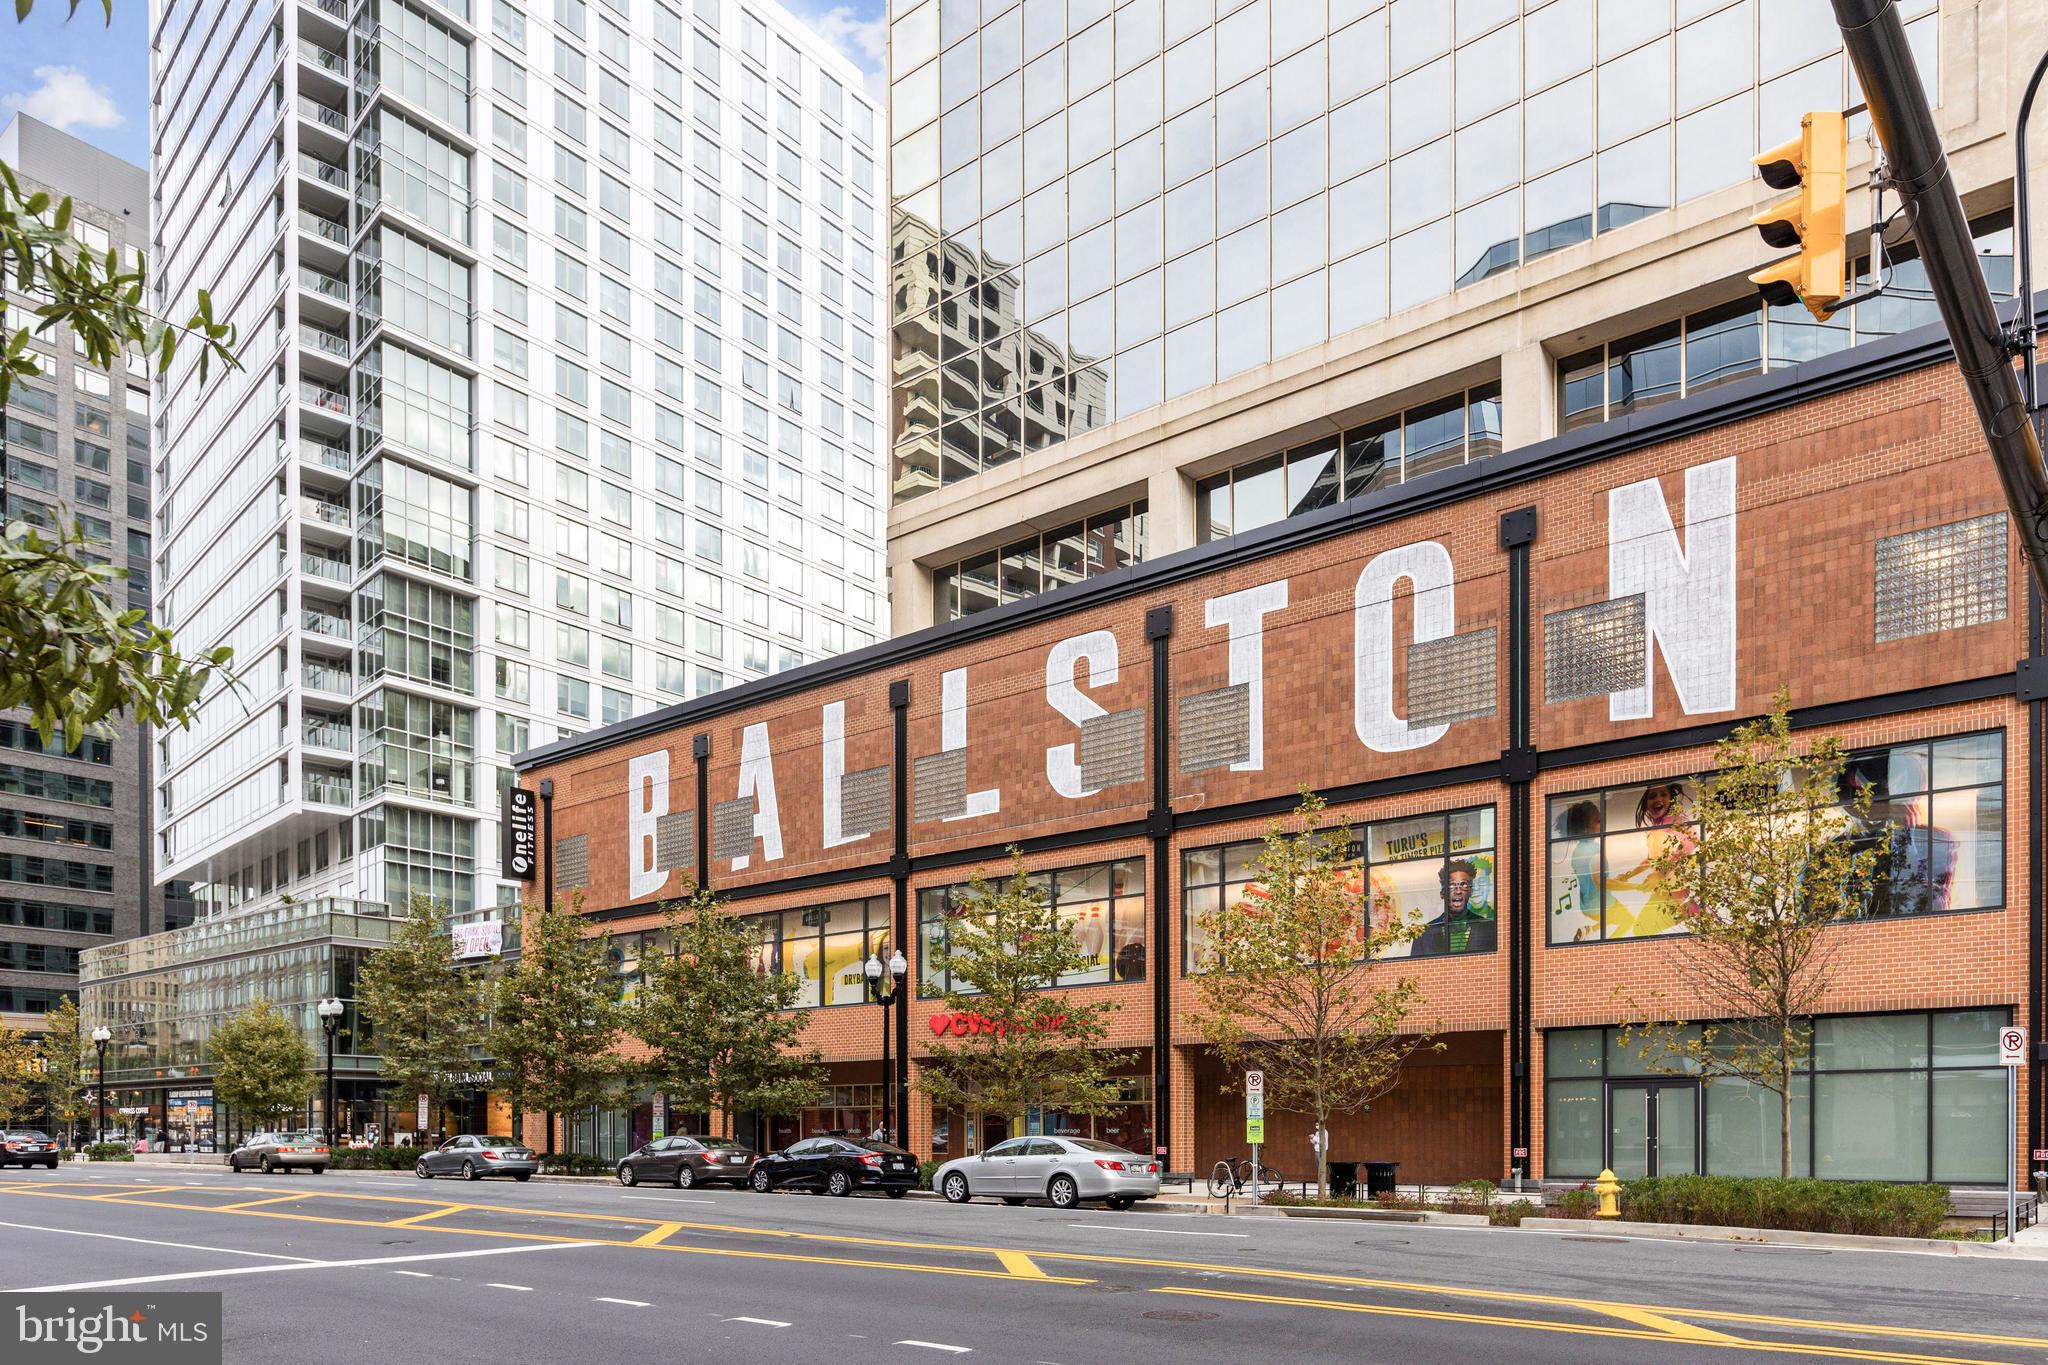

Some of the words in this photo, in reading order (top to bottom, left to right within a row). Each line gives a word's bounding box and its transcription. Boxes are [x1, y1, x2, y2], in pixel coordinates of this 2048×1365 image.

[629, 456, 1737, 899] BALLSTON
[1386, 832, 1428, 855] TURU'S
[1430, 843, 1445, 856] PIZZ
[1452, 839, 1466, 850] CO.
[844, 973, 864, 985] DRYBA
[951, 1011, 997, 1035] CVS
[1054, 1127, 1080, 1135] beverage
